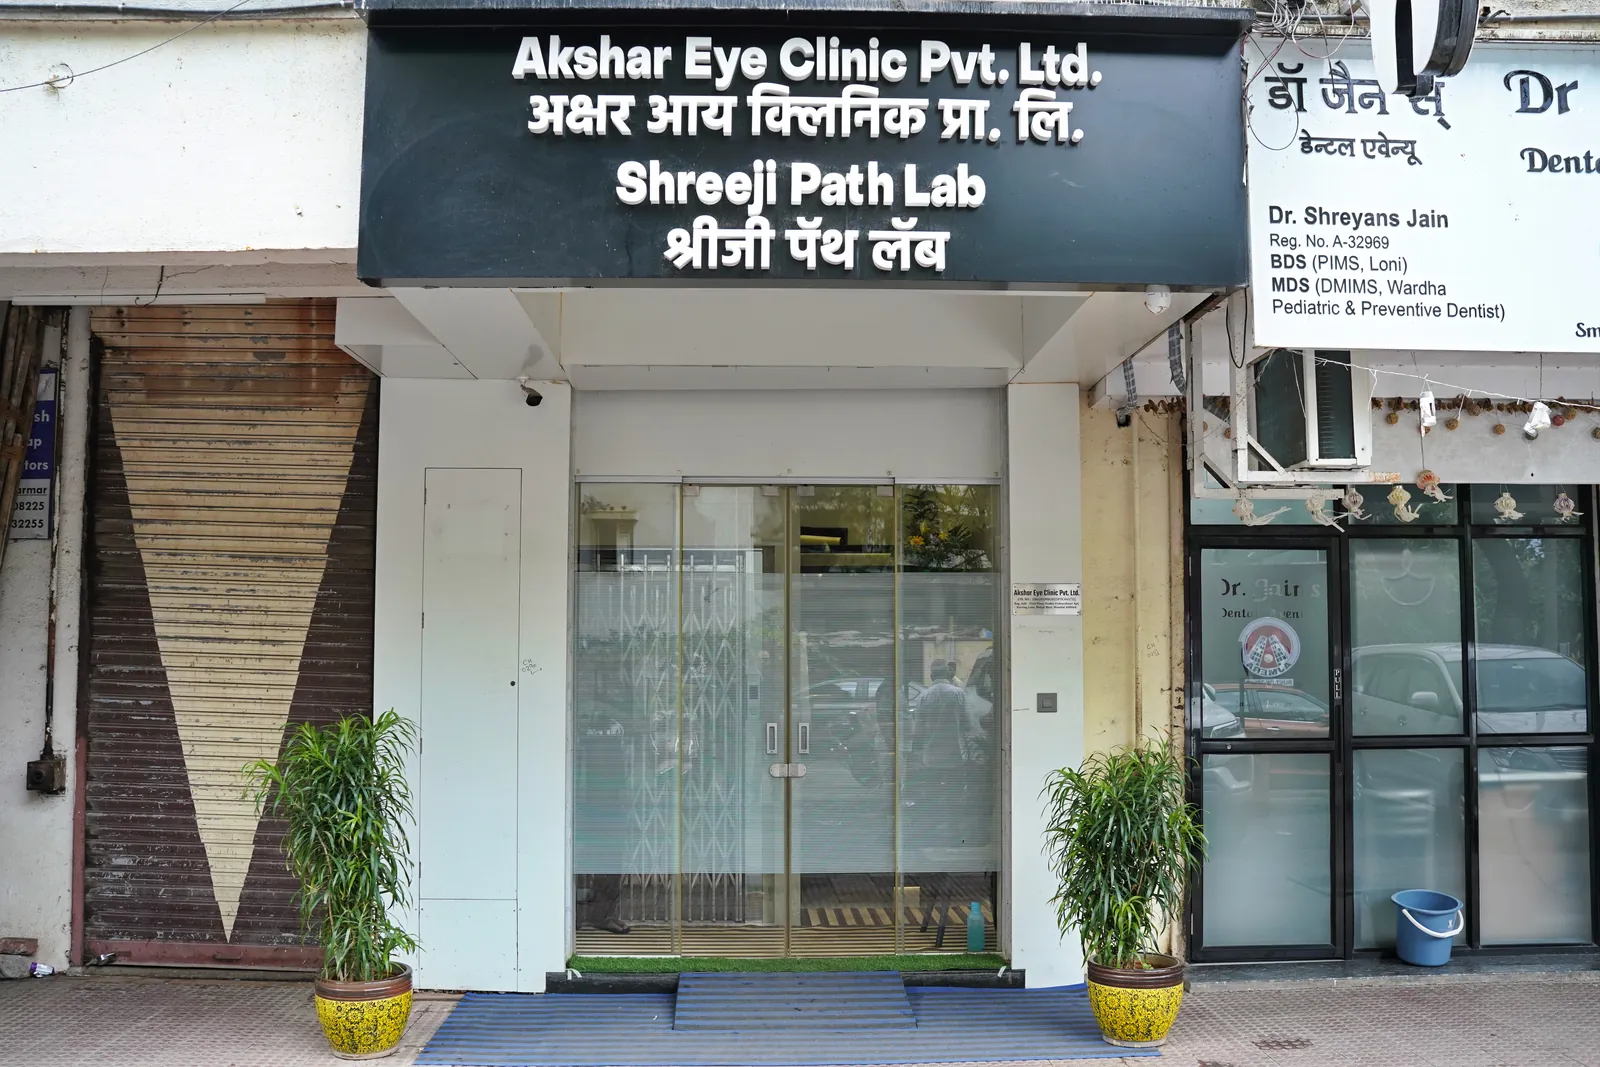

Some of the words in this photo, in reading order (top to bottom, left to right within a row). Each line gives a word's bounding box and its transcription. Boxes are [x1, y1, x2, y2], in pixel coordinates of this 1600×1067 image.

[512, 35, 672, 80] Akshar
[685, 37, 767, 91] Eye
[779, 37, 907, 82] Clinic
[920, 40, 1010, 85] Pvt.
[1019, 42, 1103, 86] Ltd.
[1264, 62, 1308, 113] डॉ
[1503, 69, 1579, 115] Dr
[527, 94, 636, 136] अक्षर
[647, 92, 738, 137] आय
[747, 83, 929, 139] क्लिनिक
[938, 97, 1001, 143] प्रा.
[1013, 89, 1084, 145] लि.
[1298, 128, 1356, 157] डेन्टल
[1360, 131, 1423, 166] एवेन्यू
[616, 159, 777, 217] Shreeji
[790, 161, 894, 207] Path
[904, 163, 986, 208] Lab
[1268, 205, 1297, 225] Dr.
[1303, 206, 1400, 231] Shreyans
[1406, 208, 1449, 229] Jain
[663, 214, 776, 271] श्रीजी
[784, 216, 859, 271] पॅथ
[867, 216, 951, 272] लॅब
[1269, 233, 1301, 250] Reg.
[1306, 235, 1329, 248] No.
[1332, 235, 1390, 250] A-32969
[1270, 253, 1307, 270] BDS
[1312, 254, 1364, 275] (PIMS,
[1369, 256, 1408, 276] Loni)
[1271, 276, 1310, 293] MDS
[1315, 277, 1382, 297] (DMIMS,
[1387, 279, 1447, 296] Wardha
[1272, 299, 1340, 316] Pediatric
[1345, 300, 1356, 316] &
[1361, 301, 1442, 318] Preventive
[1446, 302, 1505, 323] Dentist)
[24, 459, 49, 470] tors
[17, 487, 48, 495] armar
[11, 519, 44, 528] 32255
